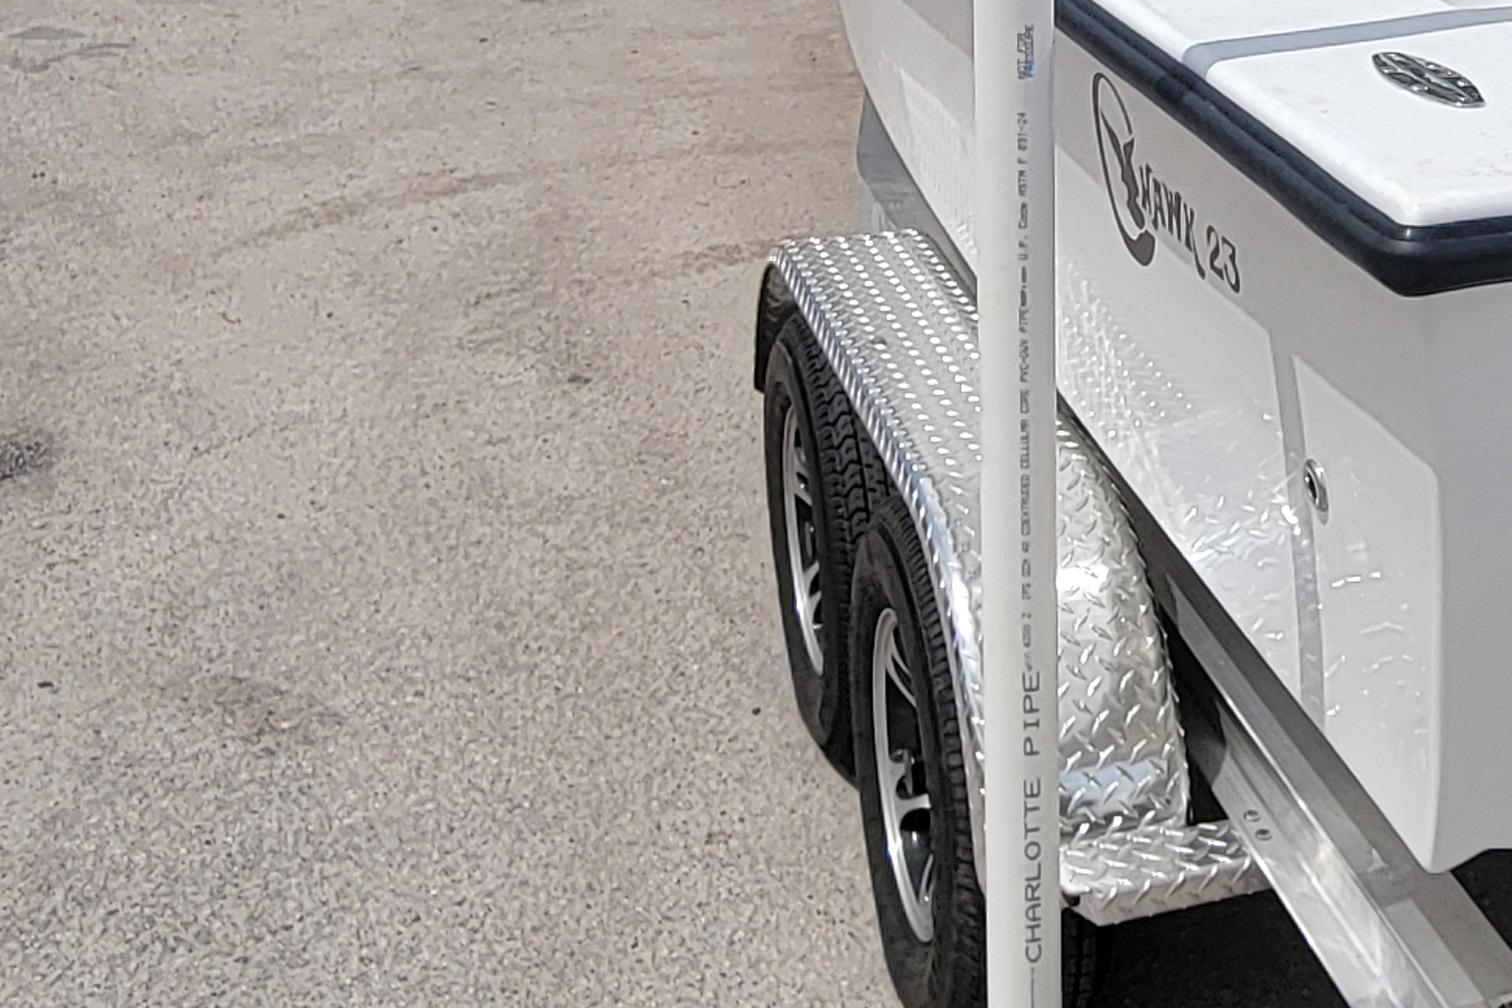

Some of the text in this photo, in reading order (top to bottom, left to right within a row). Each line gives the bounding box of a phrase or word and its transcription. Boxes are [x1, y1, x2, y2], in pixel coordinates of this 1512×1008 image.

[1206, 224, 1241, 294] 23
[1021, 668, 1041, 755] PIPE
[1023, 776, 1043, 963] CHARLOTTE
